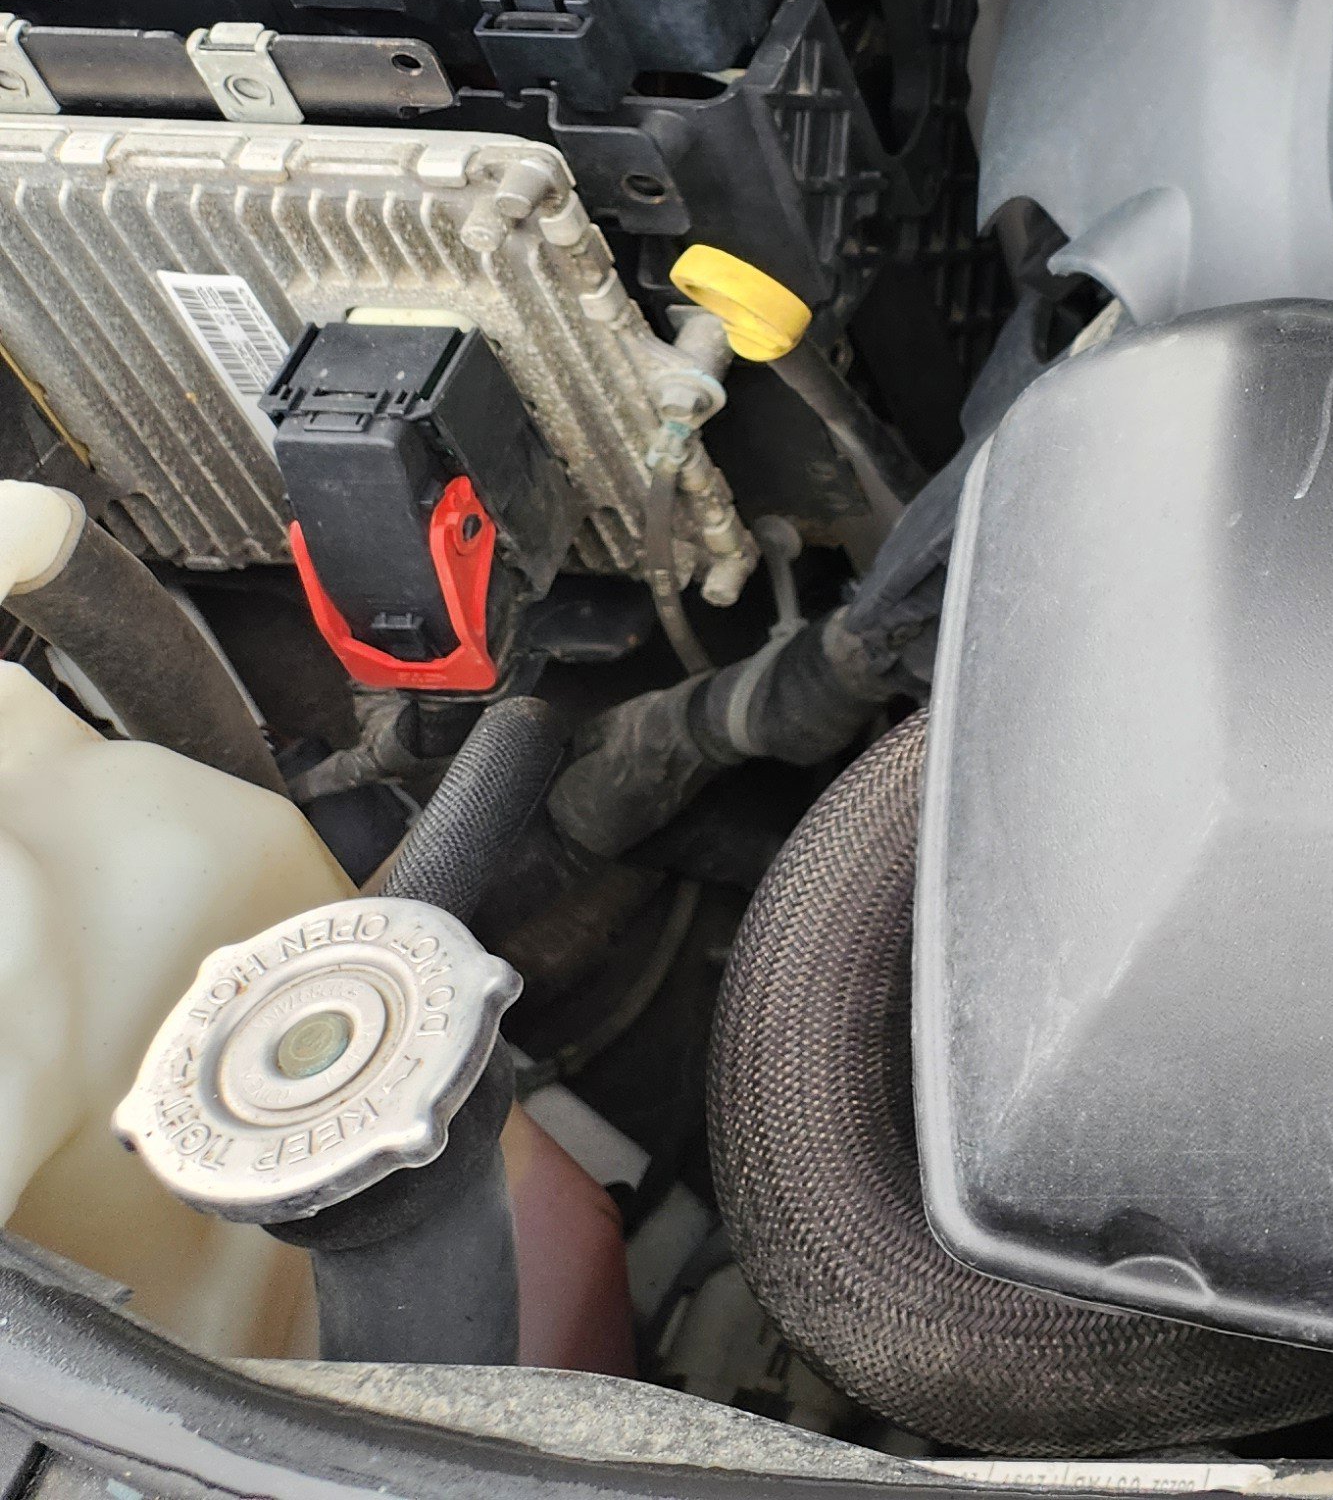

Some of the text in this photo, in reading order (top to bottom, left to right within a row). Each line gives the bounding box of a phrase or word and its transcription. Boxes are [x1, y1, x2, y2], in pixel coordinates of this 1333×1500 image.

[279, 913, 390, 963] OPEN
[392, 925, 456, 983] NOT
[189, 953, 268, 1027] HOT
[415, 983, 456, 1038] DO
[155, 1095, 380, 1171] KEEP TIGHT
